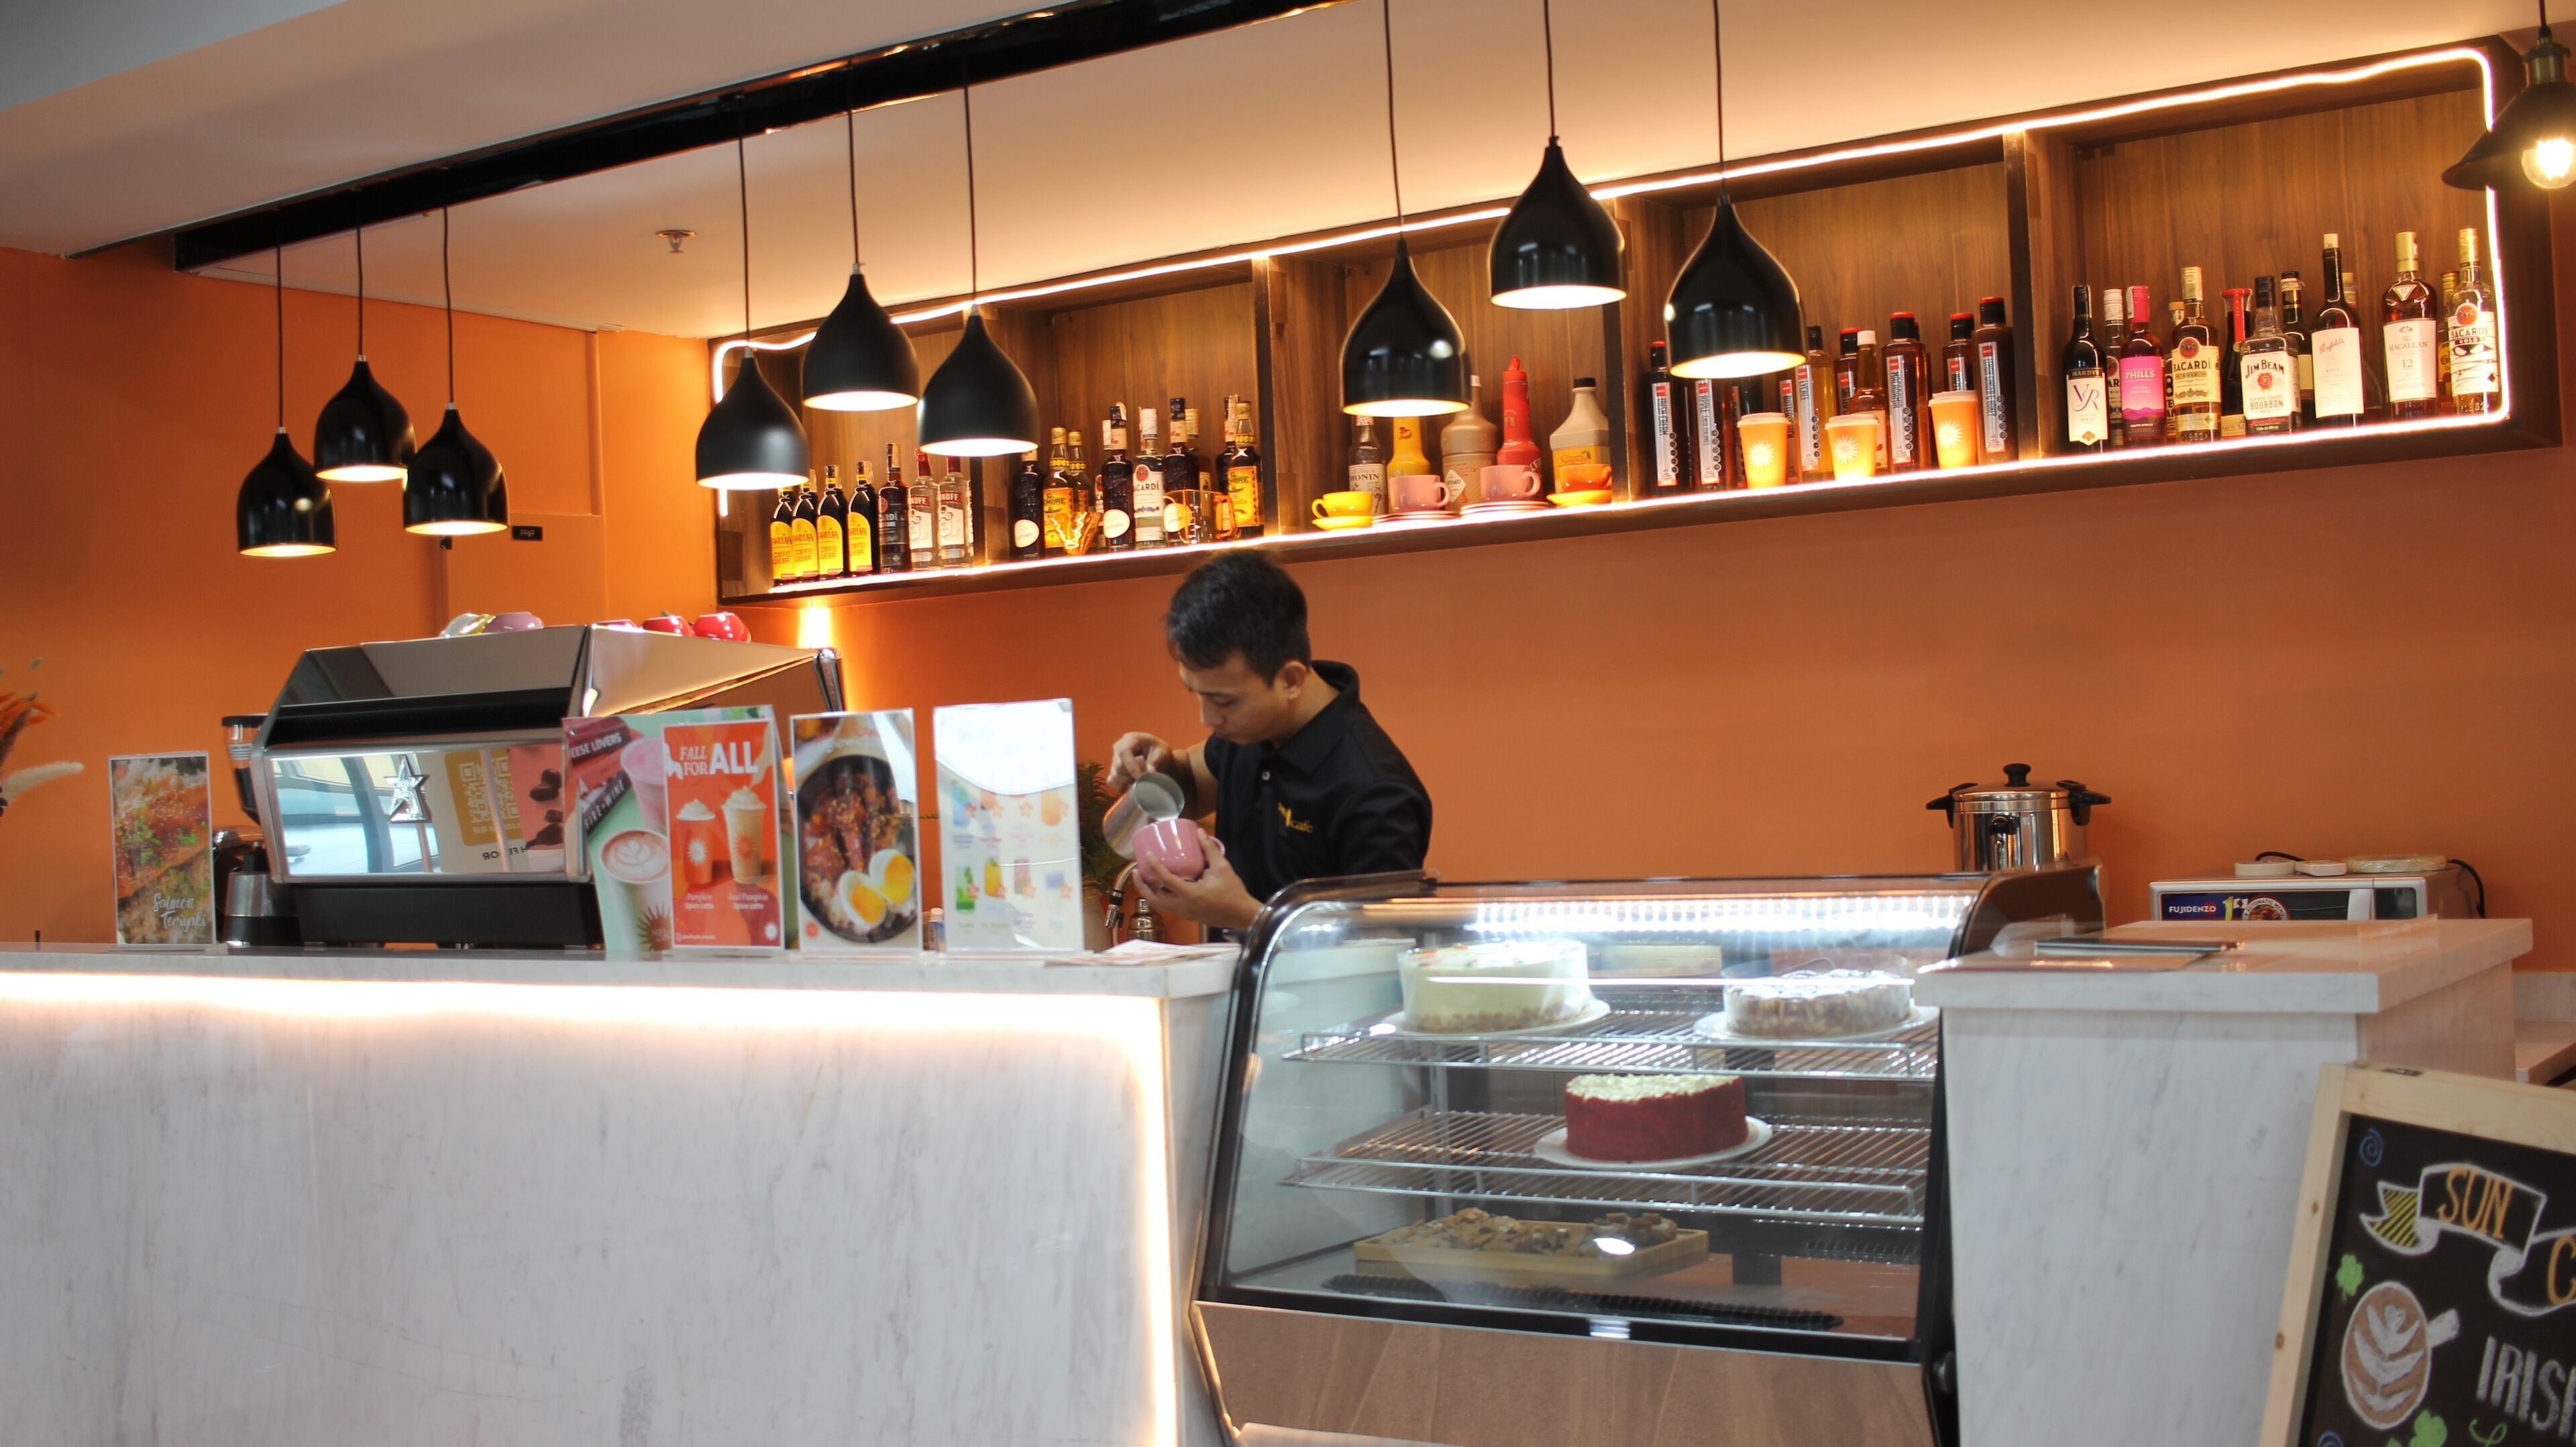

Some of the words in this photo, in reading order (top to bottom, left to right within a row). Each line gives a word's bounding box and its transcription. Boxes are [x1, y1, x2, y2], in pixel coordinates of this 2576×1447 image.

[2389, 341, 2428, 352] MACALLAN
[2245, 363, 2260, 378] JIM
[2261, 360, 2285, 374] BEAM
[2401, 359, 2414, 368] 12
[2250, 400, 2284, 411] BOURBON
[1350, 473, 1380, 482] MONIN
[1134, 481, 1160, 491] ACARDÍ
[571, 743, 591, 759] EESE
[680, 746, 708, 761] FALL
[684, 761, 709, 775] FOR
[709, 741, 759, 775] ALL
[2169, 906, 2216, 914] FUJIDENZO
[2437, 1167, 2514, 1239] SUN
